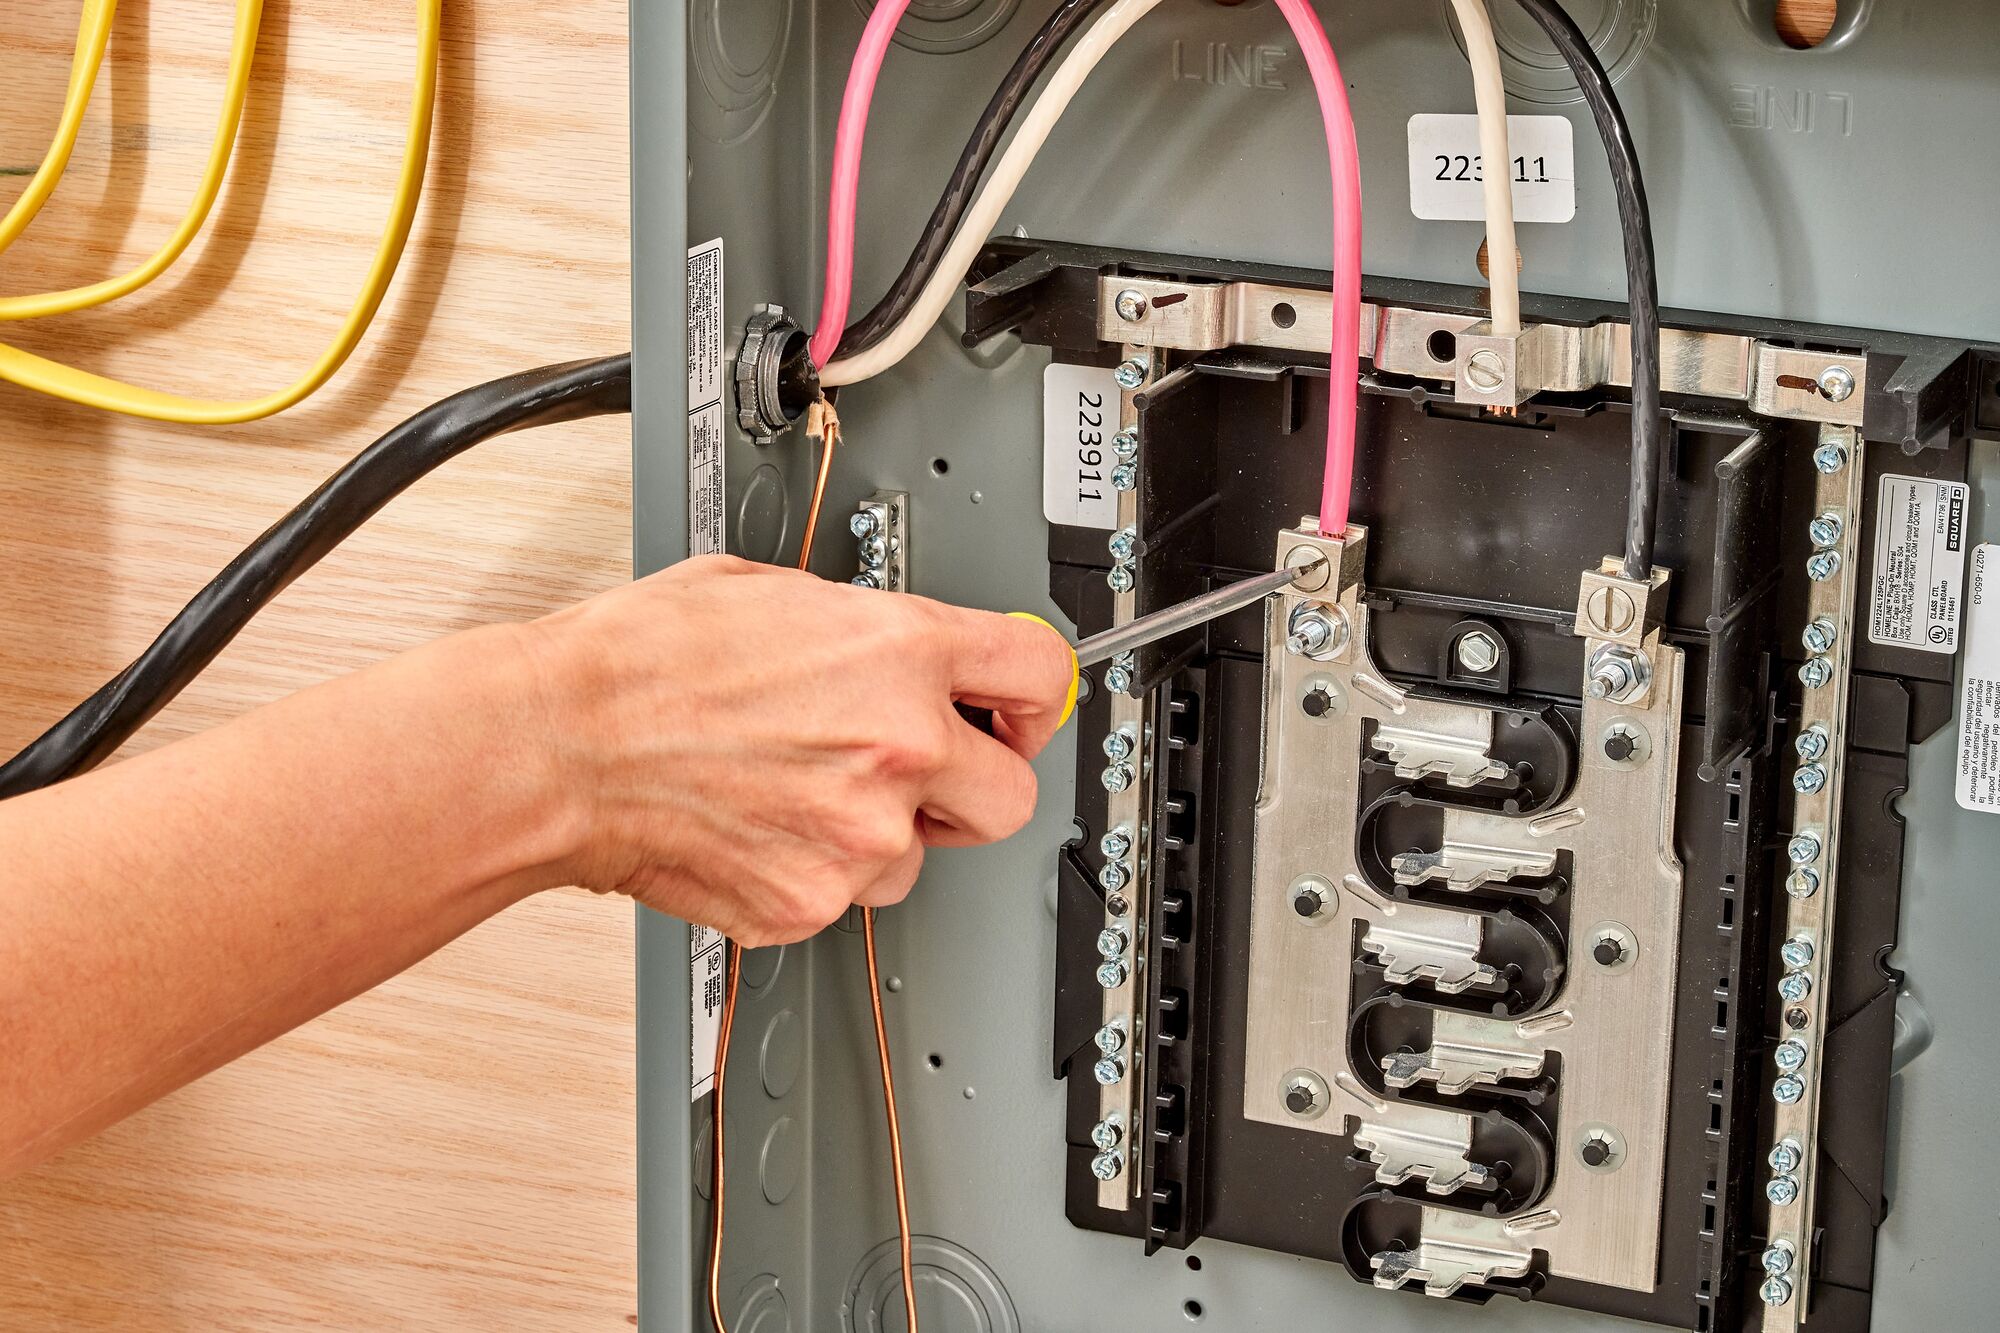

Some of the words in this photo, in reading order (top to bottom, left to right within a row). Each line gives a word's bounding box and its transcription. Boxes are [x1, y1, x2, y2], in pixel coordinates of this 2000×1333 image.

[1172, 40, 1287, 89] LINE
[1729, 83, 1854, 136] LINE
[1435, 155, 1549, 182] 22311
[1079, 392, 1102, 502] 223911
[1950, 501, 1960, 549] SQUARE
[1887, 574, 1896, 598] Plug-On
[1902, 555, 1910, 587] accessories
[1974, 549, 1985, 605] 40271-650-03
[1875, 576, 1885, 636] HOM1224L125PGC
[1899, 595, 1908, 614] Square
[1930, 600, 1938, 619] CLASS
[1939, 580, 1947, 620] PANELBOARD
[1899, 616, 1907, 627] only
[1965, 687, 1975, 734] confiabilidad
[1976, 679, 1985, 716] seguridad
[1985, 681, 1994, 707] afectar
[1973, 731, 1981, 759] usuario
[1992, 724, 2000, 735] del
[1962, 749, 1970, 776] equipo.
[1980, 724, 1990, 779] negativamente
[1990, 740, 1999, 771] petróleo
[1970, 766, 1979, 803] deteriorar
